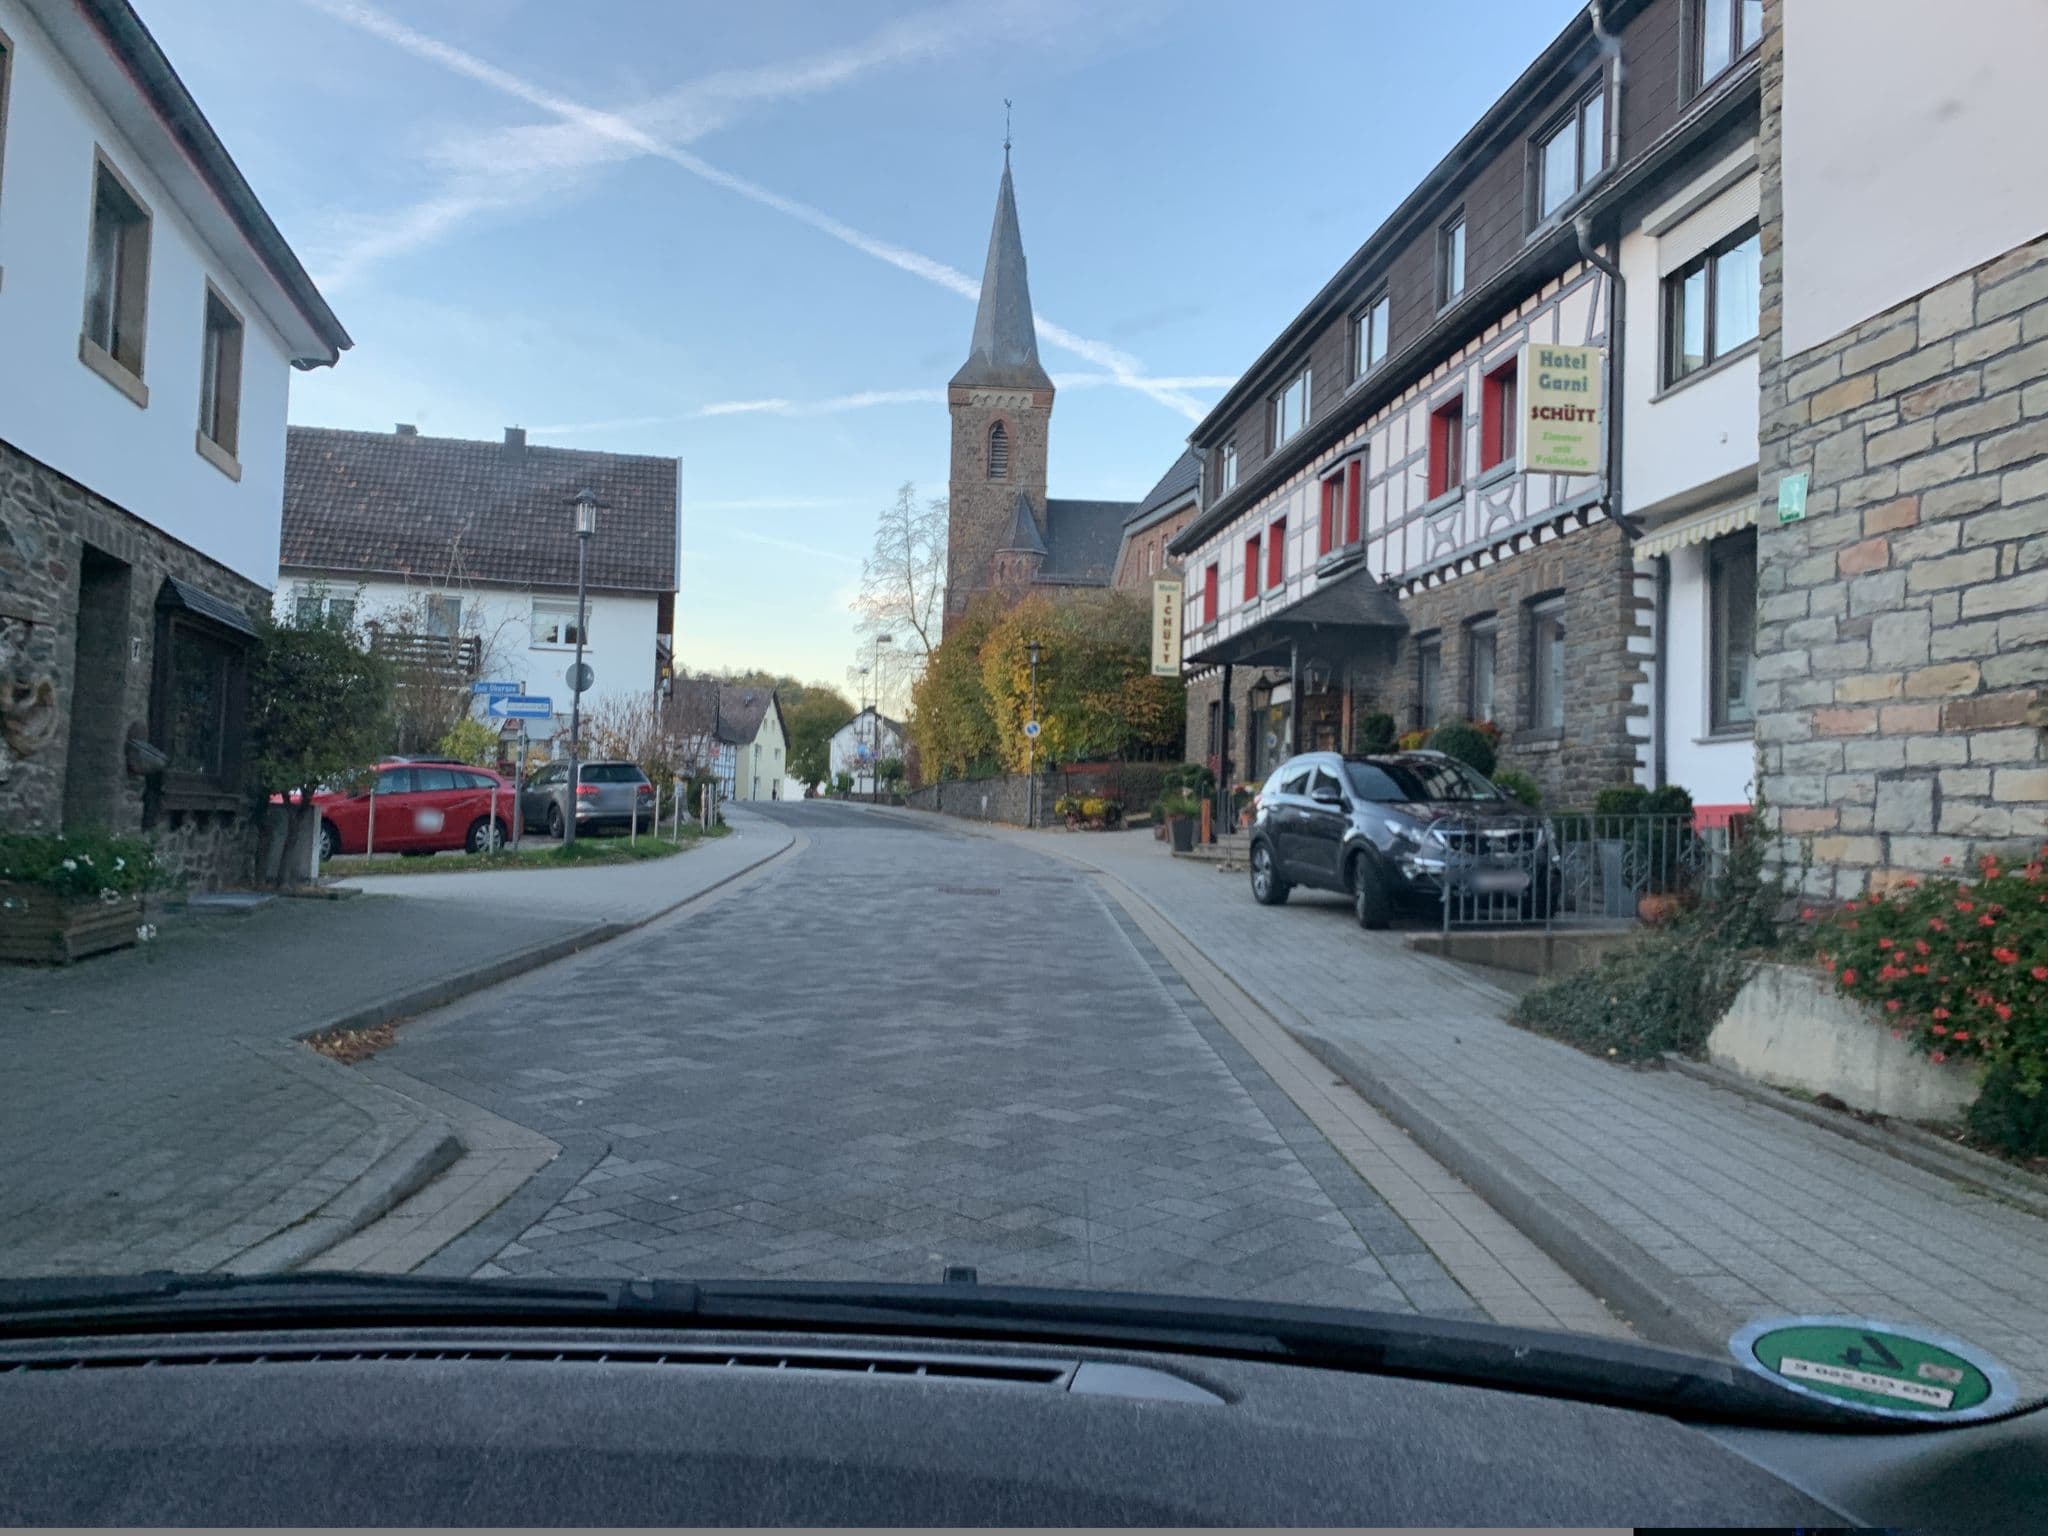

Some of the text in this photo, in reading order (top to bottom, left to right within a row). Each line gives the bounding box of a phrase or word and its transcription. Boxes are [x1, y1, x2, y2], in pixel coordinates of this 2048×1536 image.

[1540, 351, 1587, 369] Hotel
[1539, 373, 1588, 392] Garni
[1531, 404, 1596, 422] SCHÜTT
